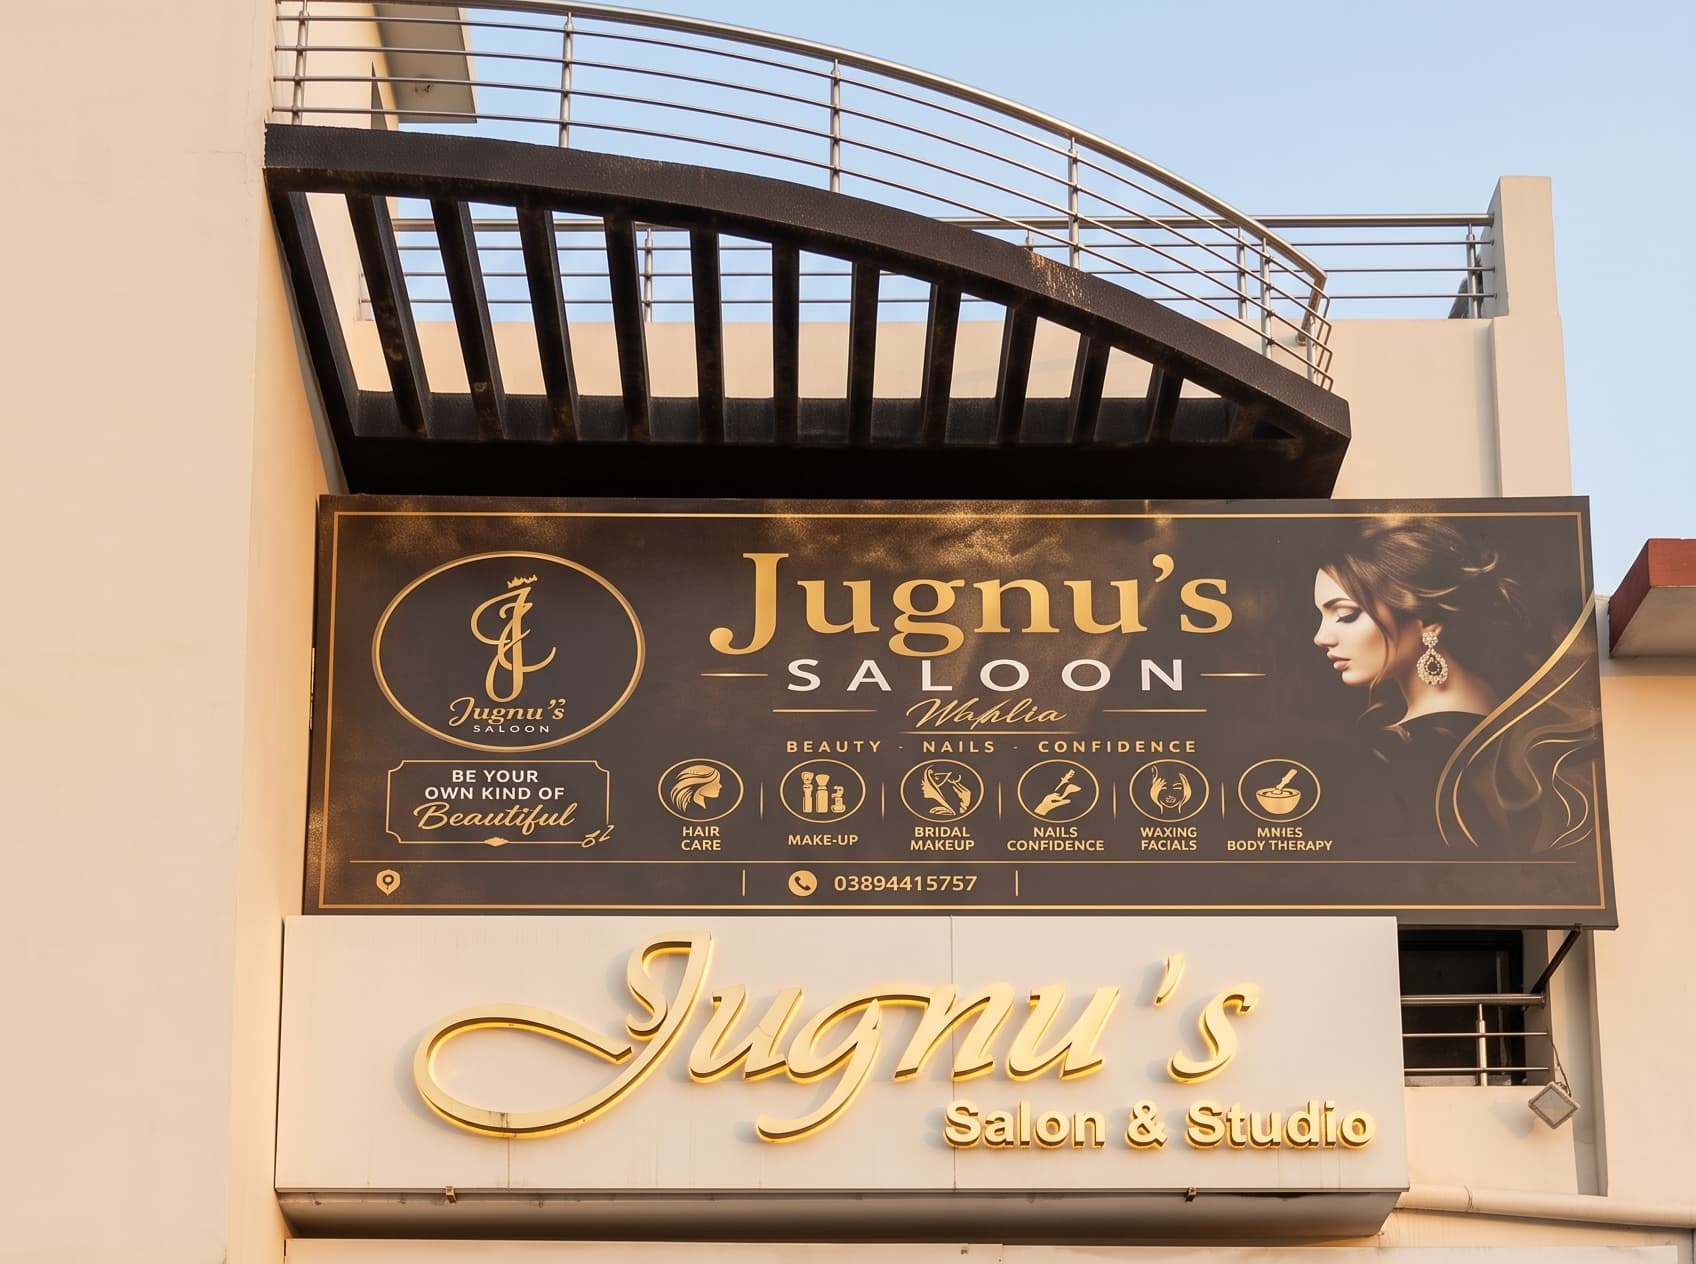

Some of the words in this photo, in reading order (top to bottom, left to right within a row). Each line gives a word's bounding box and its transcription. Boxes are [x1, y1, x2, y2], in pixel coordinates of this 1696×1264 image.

[708, 551, 1234, 656] Jugnu's
[787, 658, 1184, 692] SALOON
[473, 725, 550, 733] SALOON
[786, 740, 881, 753] BEAUTY
[923, 740, 994, 753] NAILS
[1038, 740, 1195, 753] CONFIDENCE
[452, 769, 477, 783] BE
[483, 769, 538, 783] YOUR
[424, 786, 473, 800] OWN
[482, 787, 531, 800] KIND
[538, 787, 565, 800] OF
[413, 801, 578, 836] Beautiful
[682, 825, 720, 837] HAIR
[914, 826, 971, 838] BRIDAL
[1033, 826, 1078, 838] NAILS
[1140, 827, 1197, 838] WAXING
[681, 839, 721, 851] CARE
[788, 834, 858, 846] MAKE-UP
[910, 839, 975, 851] MAKEUP
[1007, 839, 1105, 851] CONFIDENCE
[1141, 839, 1197, 851] FACIALS
[1227, 840, 1266, 851] BODY
[1268, 840, 1333, 851] THERAPY
[834, 875, 978, 891] 03894415757
[412, 931, 1259, 1143] Jugnu's
[943, 1099, 1106, 1150] Salon
[1125, 1099, 1169, 1150] &
[1185, 1099, 1376, 1150] Studio
